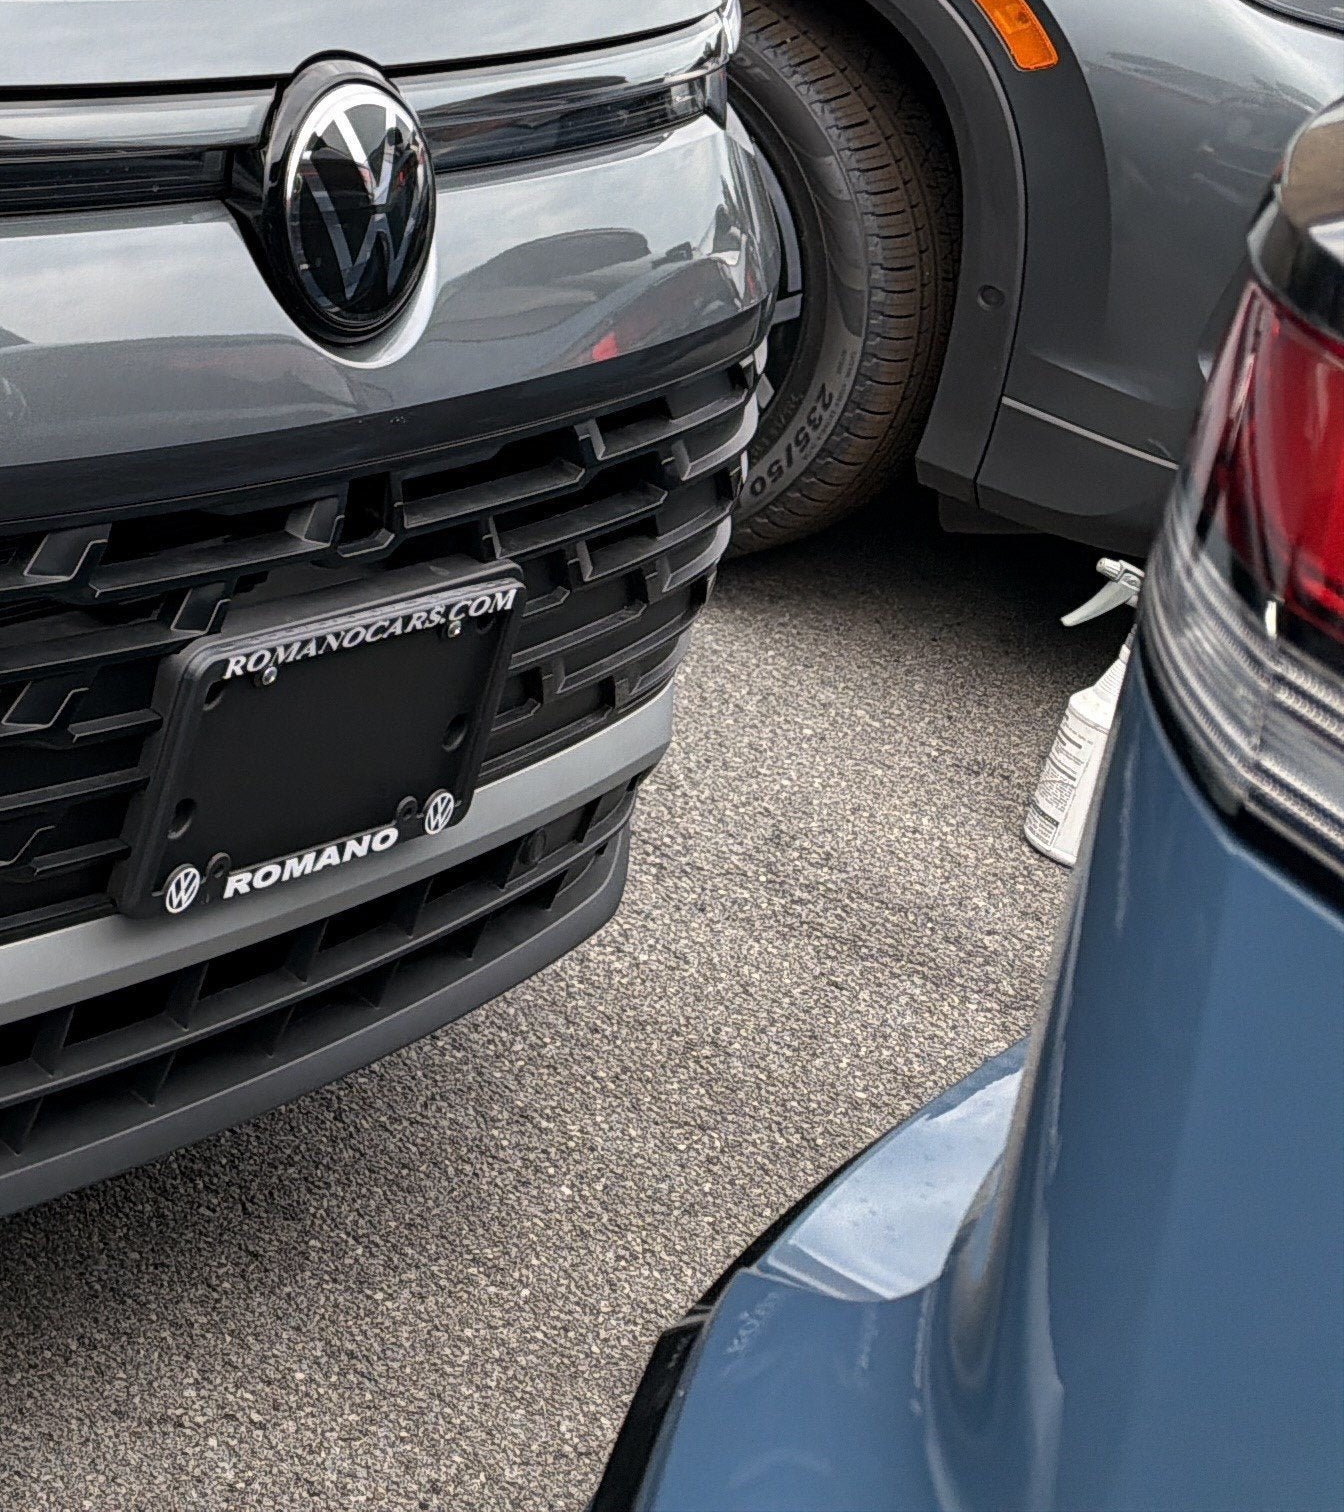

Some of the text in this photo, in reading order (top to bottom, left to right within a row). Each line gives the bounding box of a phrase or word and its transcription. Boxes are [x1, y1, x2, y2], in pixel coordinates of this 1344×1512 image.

[749, 381, 834, 497] 235/50
[222, 587, 518, 681] ROMANOCARS.COM
[222, 826, 399, 900] ROMANO
